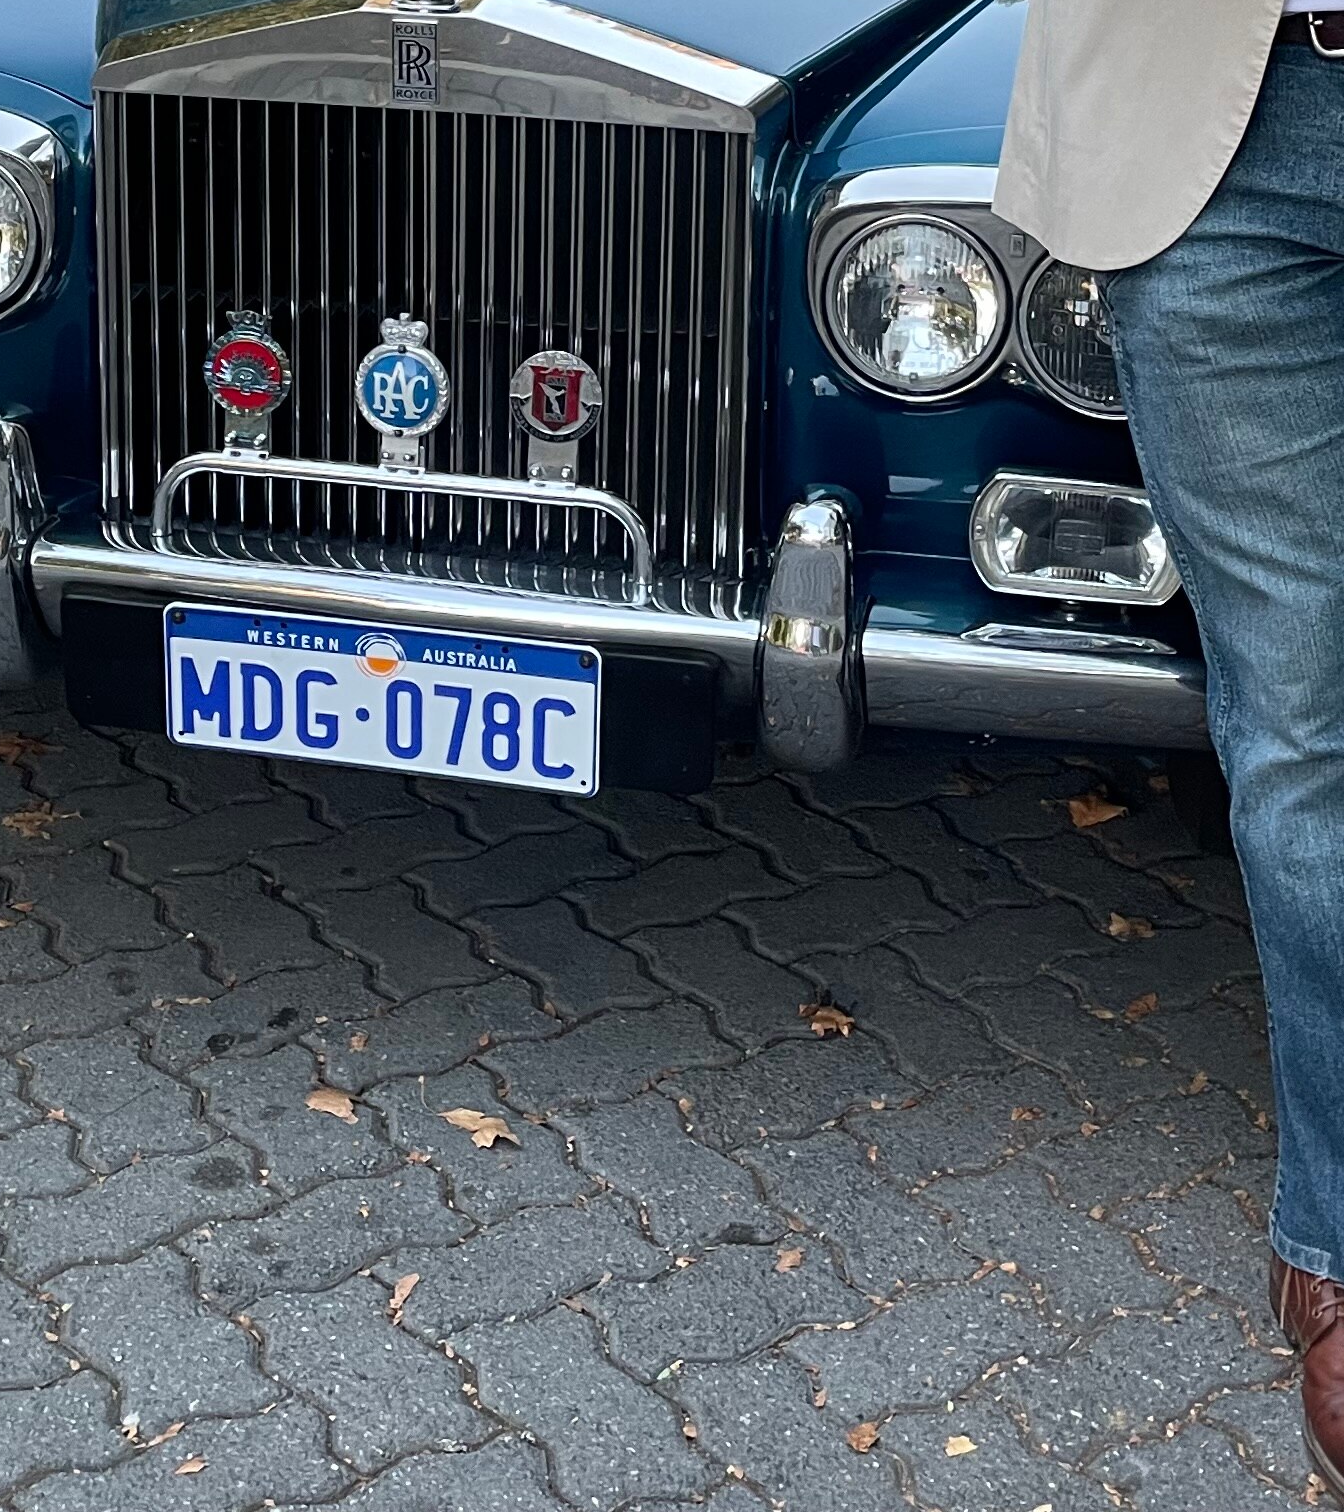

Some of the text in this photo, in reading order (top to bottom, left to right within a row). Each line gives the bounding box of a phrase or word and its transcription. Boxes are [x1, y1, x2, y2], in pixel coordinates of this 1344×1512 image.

[395, 24, 434, 36] ROLLS
[398, 39, 432, 86] RR
[395, 89, 434, 100] ROYCE
[372, 361, 429, 420] RAC
[247, 629, 518, 673] WESTERN AUSTRALIA
